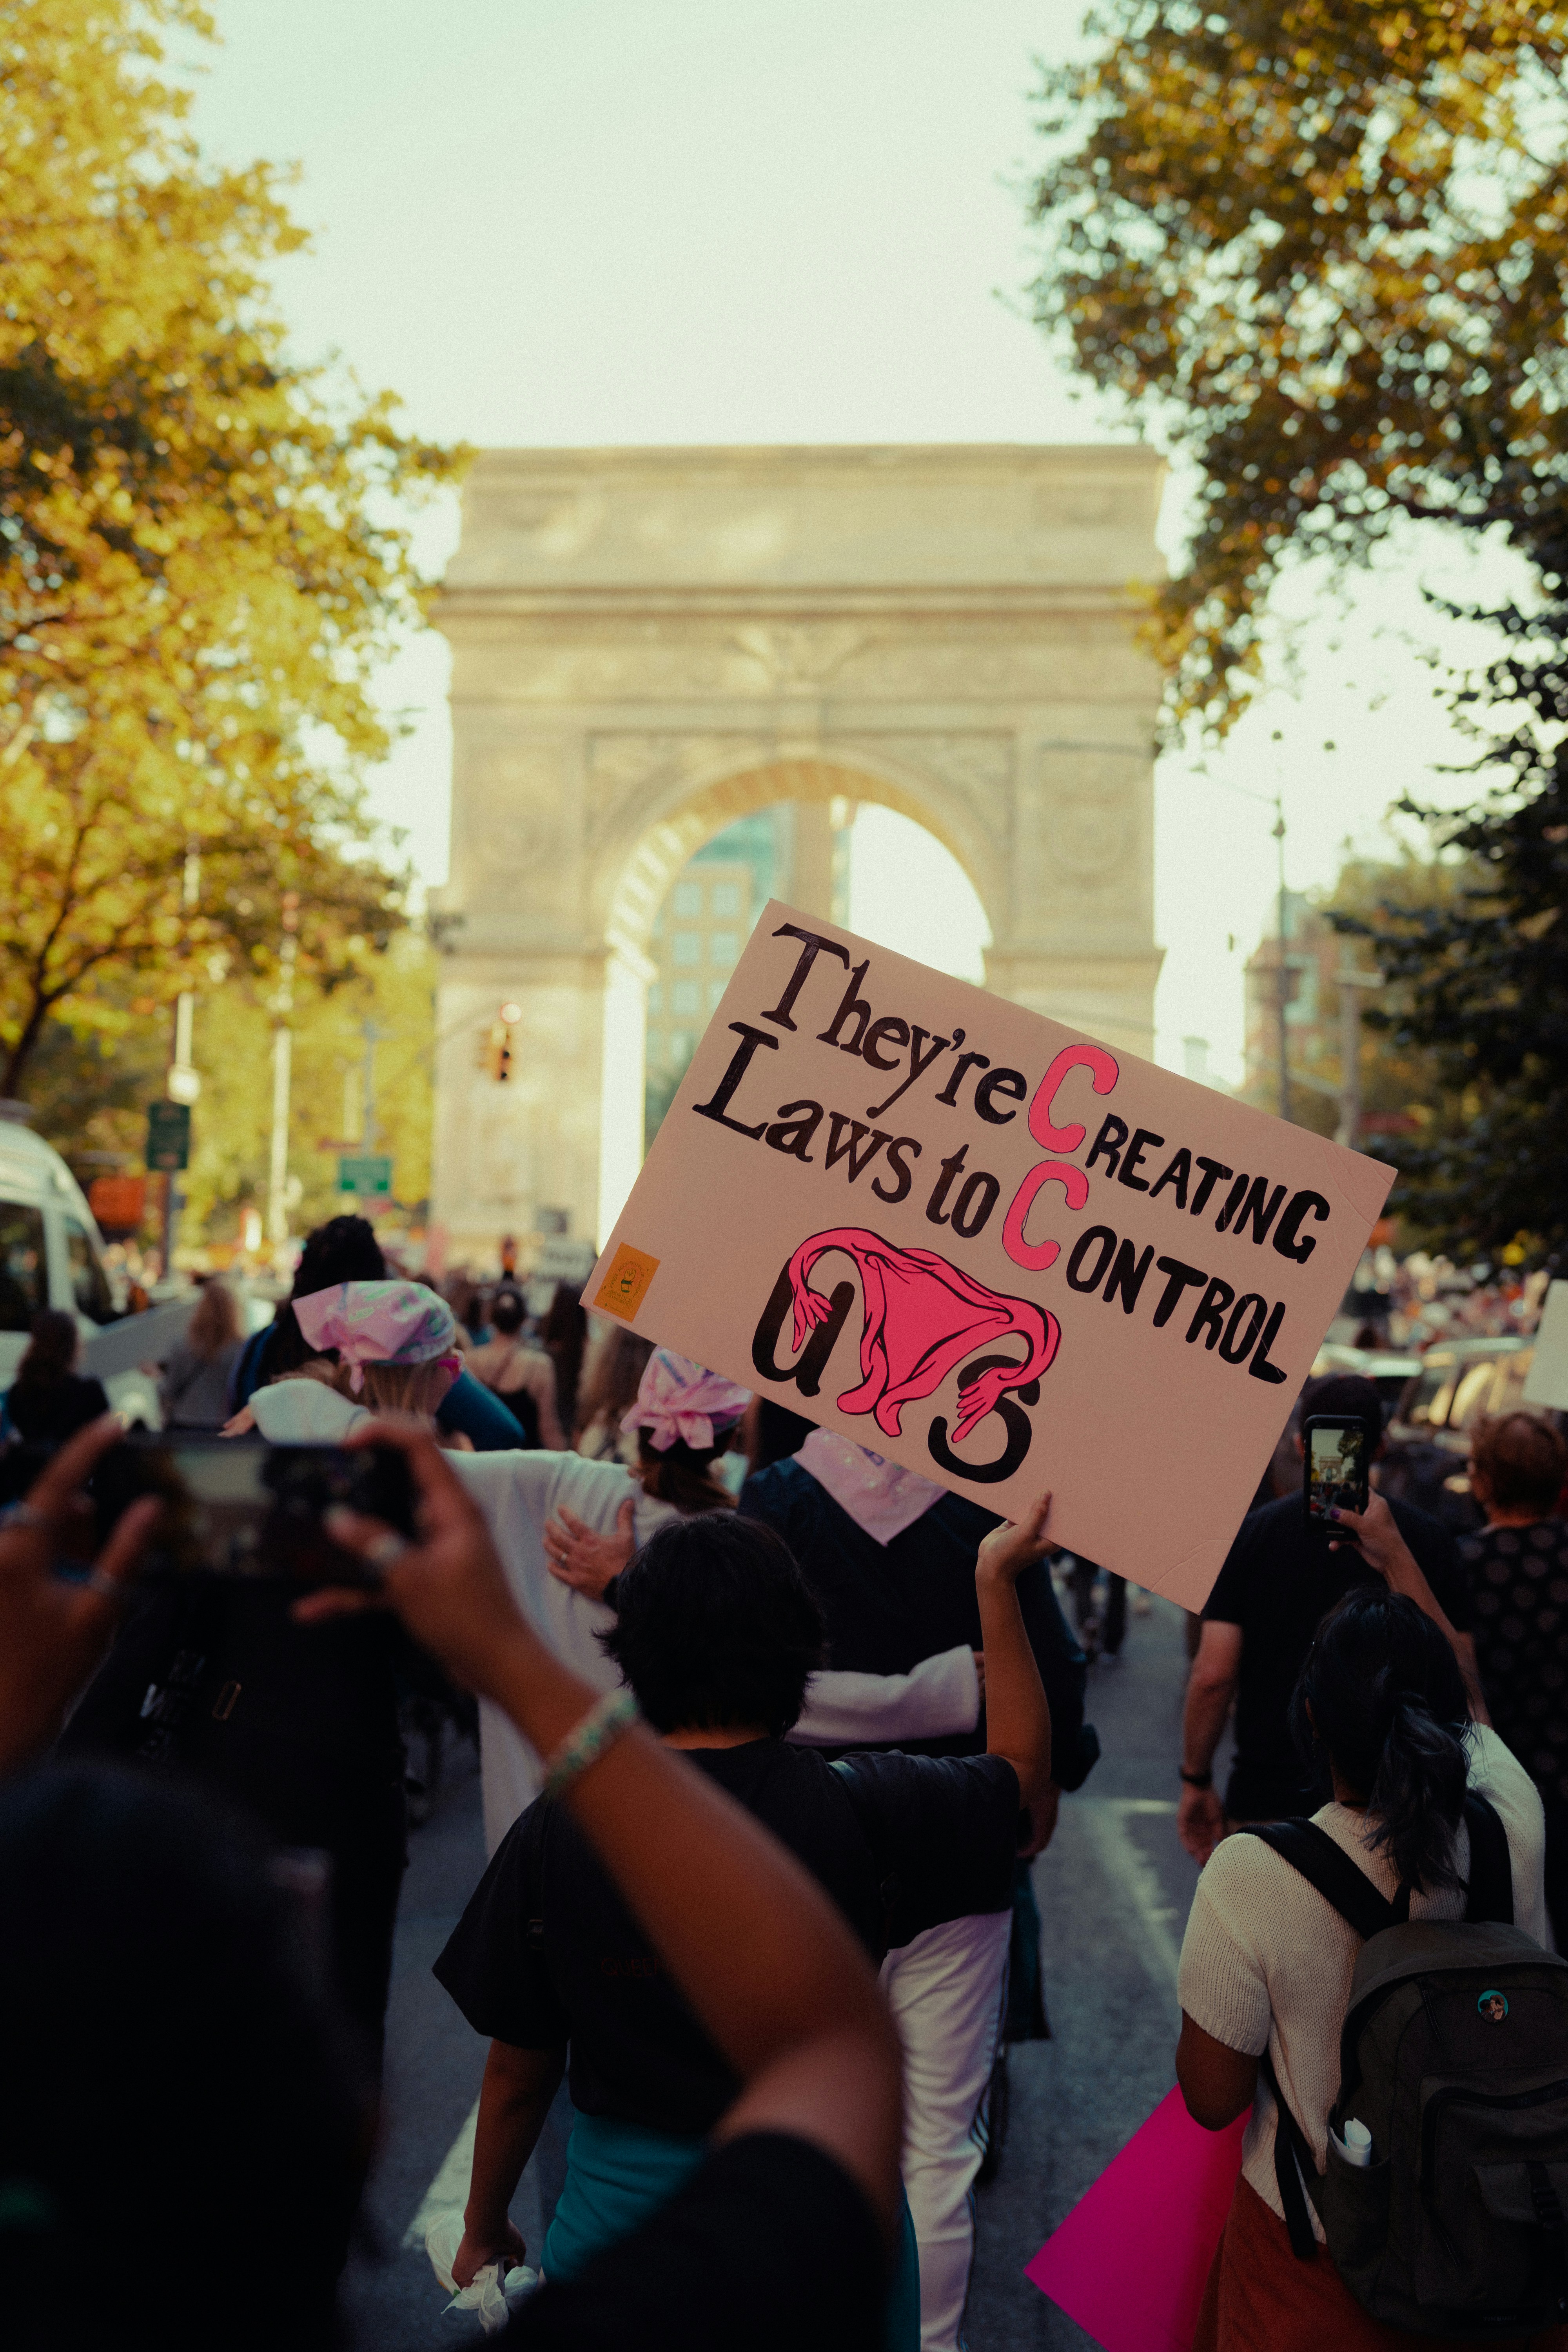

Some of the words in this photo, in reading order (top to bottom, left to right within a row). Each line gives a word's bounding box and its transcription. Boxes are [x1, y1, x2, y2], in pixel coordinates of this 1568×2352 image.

[692, 1022, 922, 1203] Laws
[926, 1144, 1000, 1238] to
[1002, 1161, 1287, 1384] CONTROL
[761, 923, 1027, 1125] They're
[1029, 1045, 1330, 1264] CREATING
